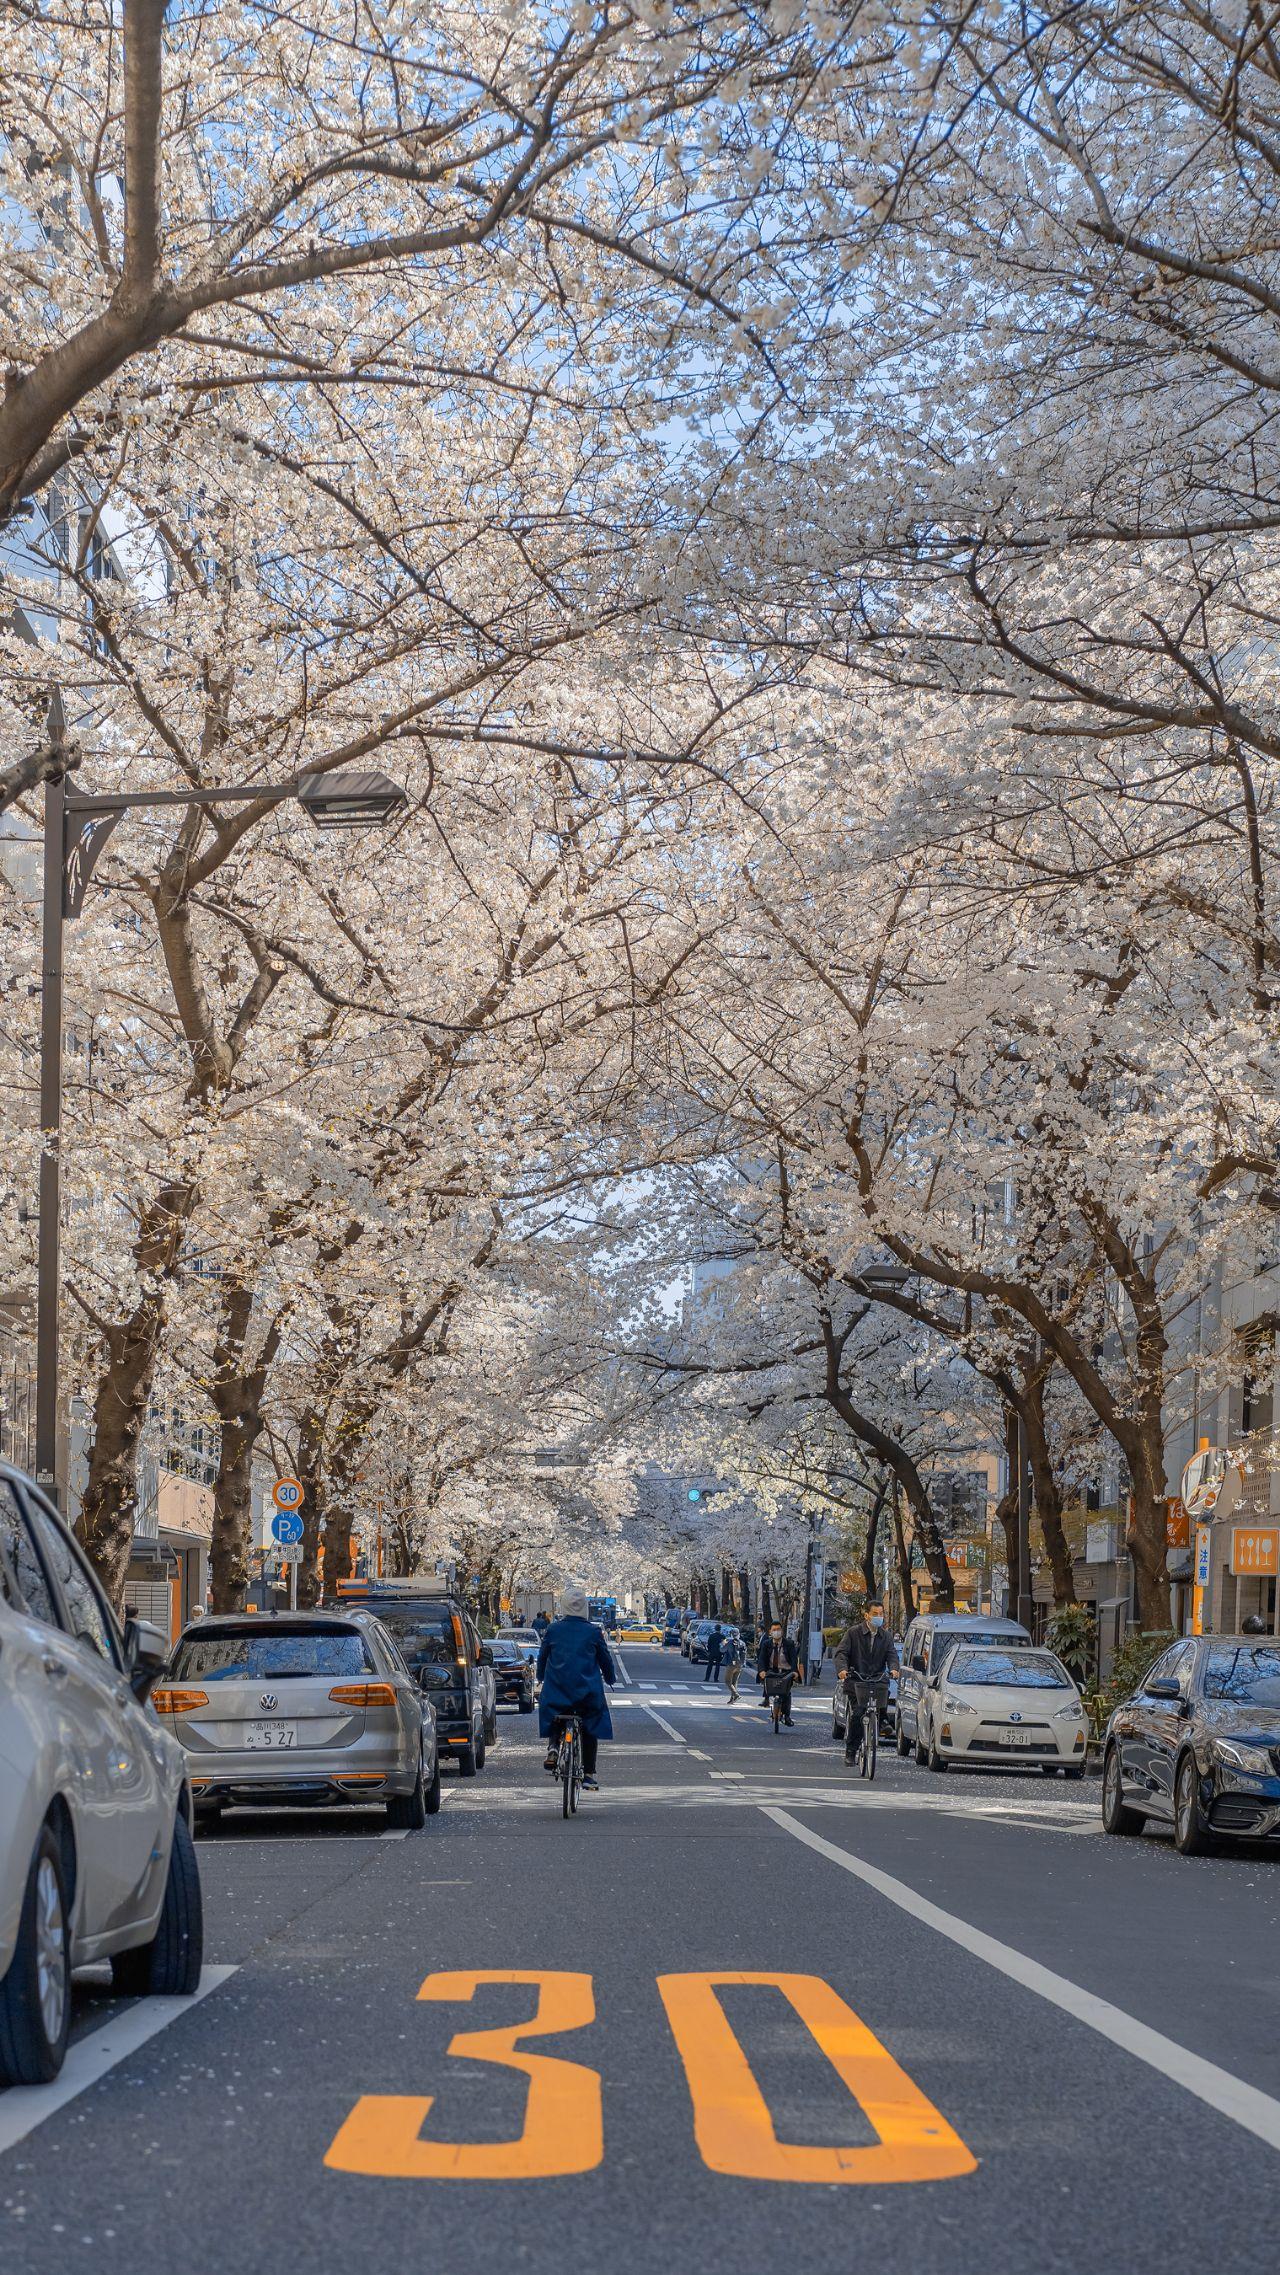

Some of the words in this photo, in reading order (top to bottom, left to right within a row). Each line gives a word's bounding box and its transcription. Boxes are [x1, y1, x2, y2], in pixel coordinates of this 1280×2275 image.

[280, 1487, 297, 1501] 30
[279, 1520, 291, 1540] P
[1199, 1549, 1208, 1580] 注意
[323, 1969, 979, 2183] 30
